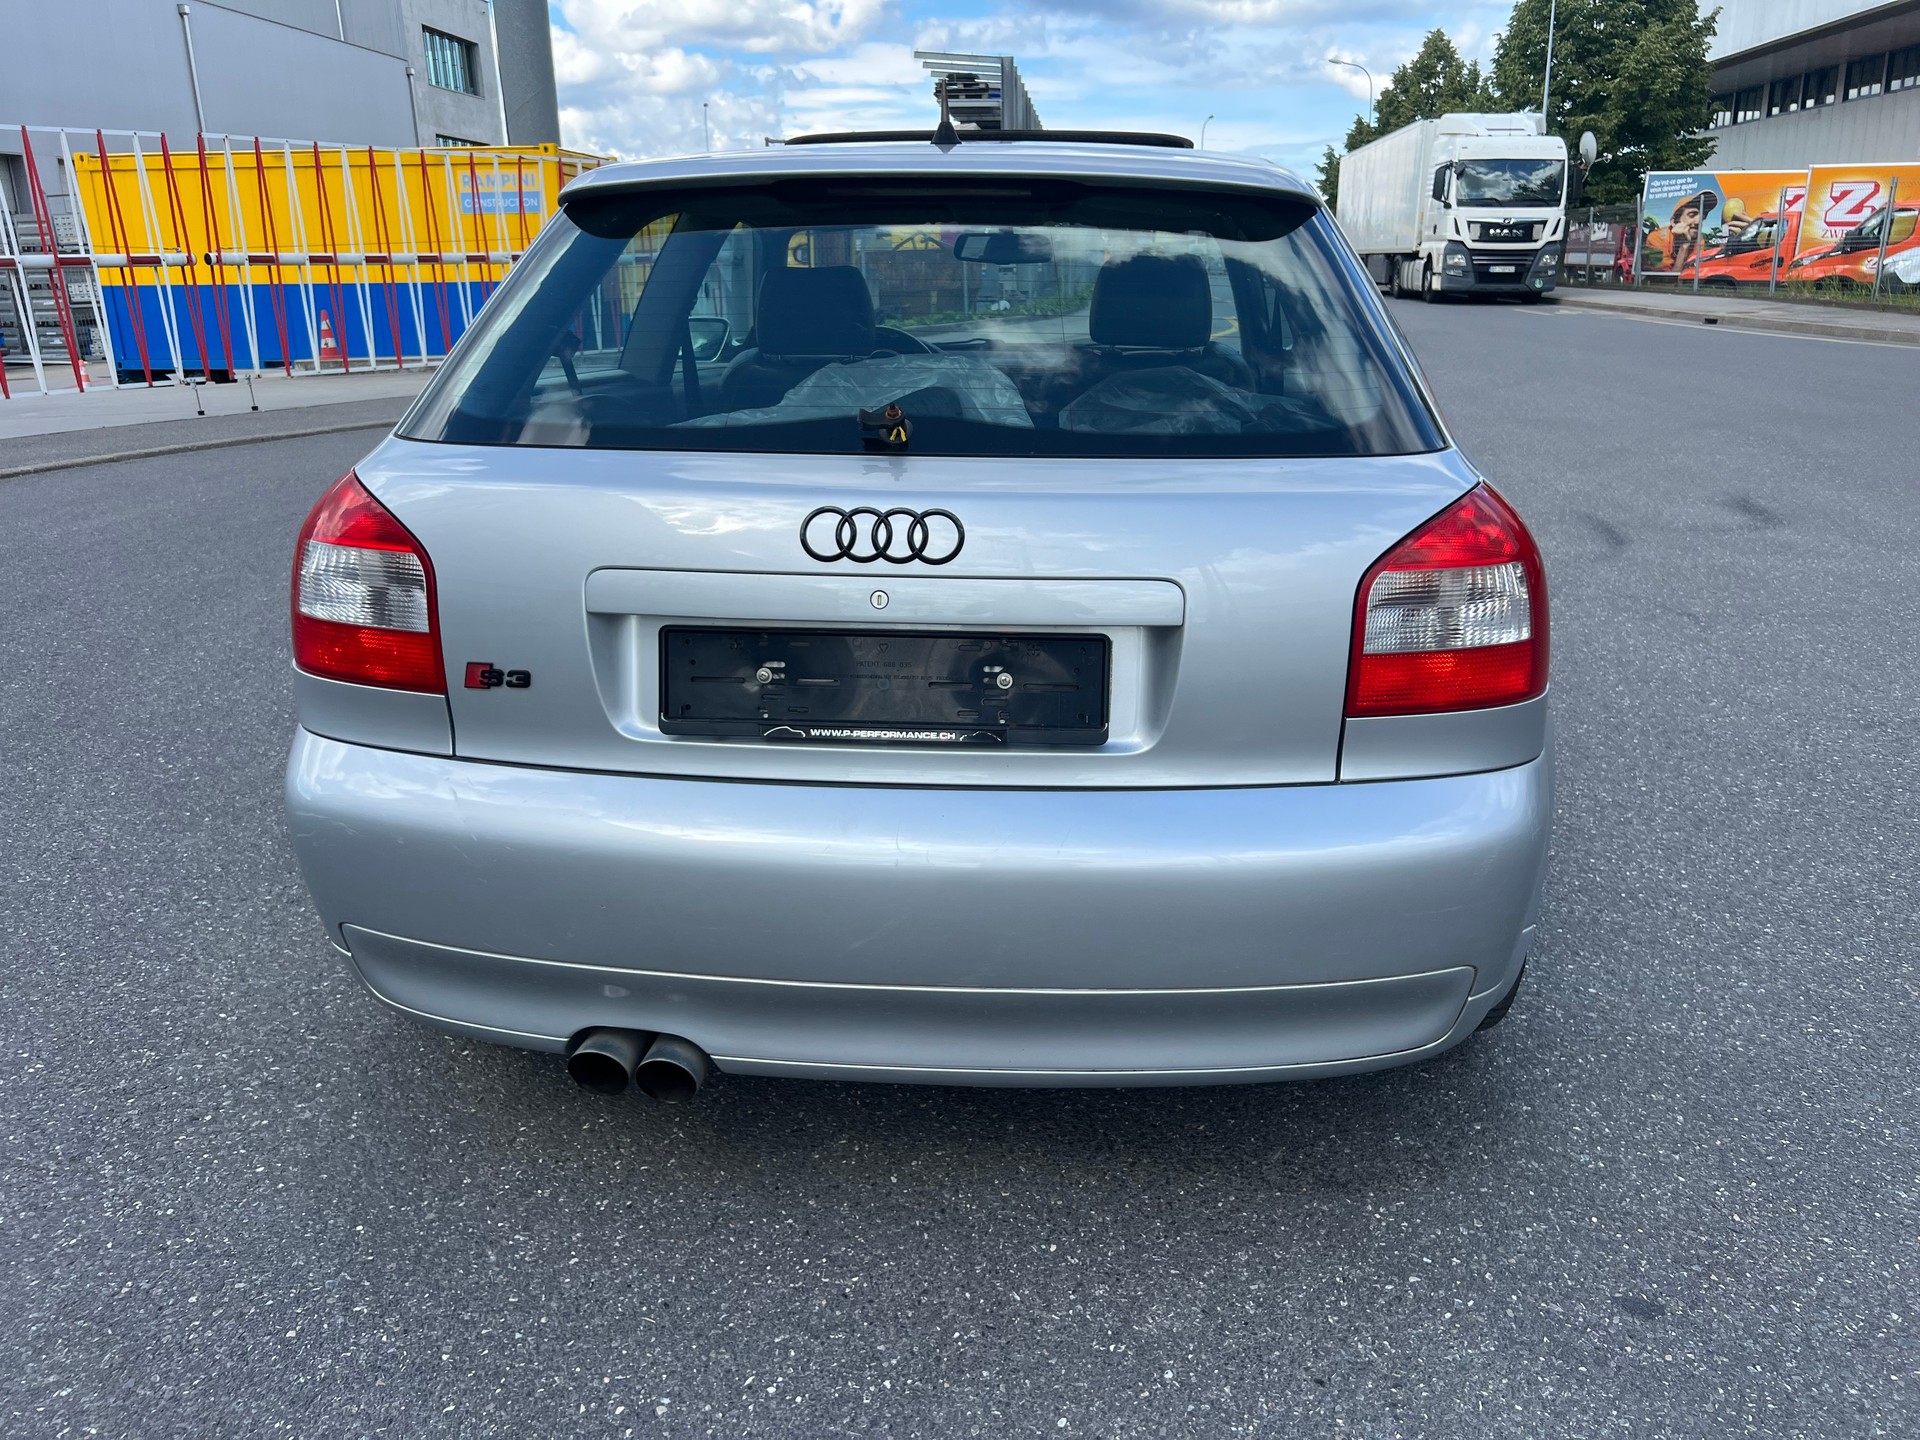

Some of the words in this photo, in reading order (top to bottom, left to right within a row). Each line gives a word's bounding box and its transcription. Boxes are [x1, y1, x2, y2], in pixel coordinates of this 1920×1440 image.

[1489, 228, 1525, 237] MAN
[478, 669, 531, 689] S3
[809, 728, 956, 741] WWW.P-PERFORMANCE.CH
